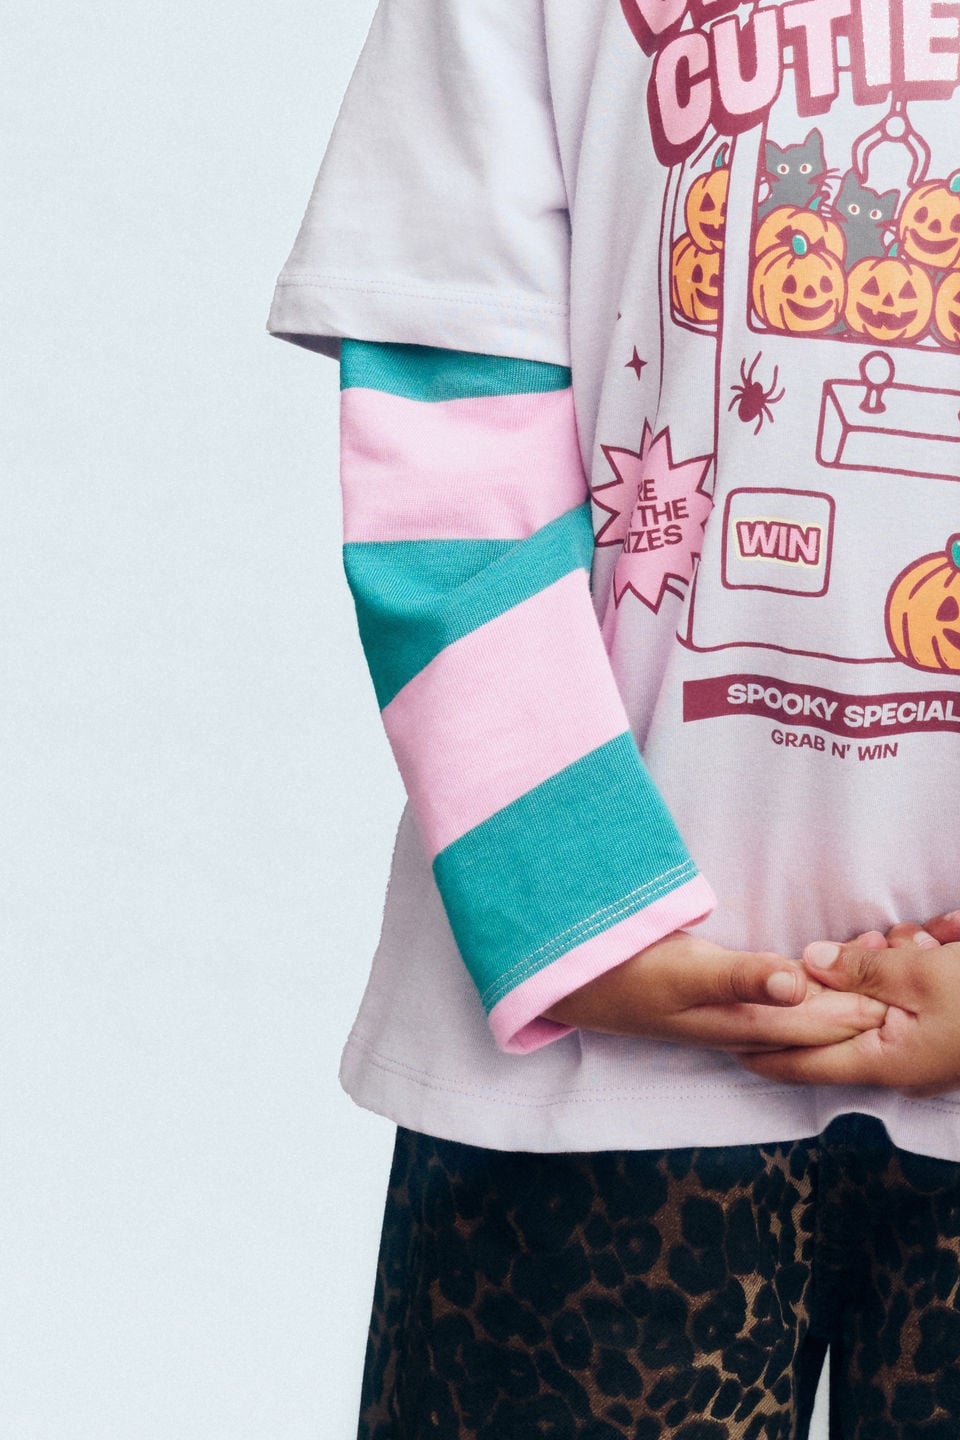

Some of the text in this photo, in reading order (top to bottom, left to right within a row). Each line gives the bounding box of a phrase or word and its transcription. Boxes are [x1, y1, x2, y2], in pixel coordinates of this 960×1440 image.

[637, 497, 689, 527] THE
[624, 524, 683, 554] IZES
[736, 521, 822, 566] WIN
[727, 683, 838, 722] SPOOKY
[771, 729, 825, 752] GRAB
[857, 742, 899, 761] WIN
